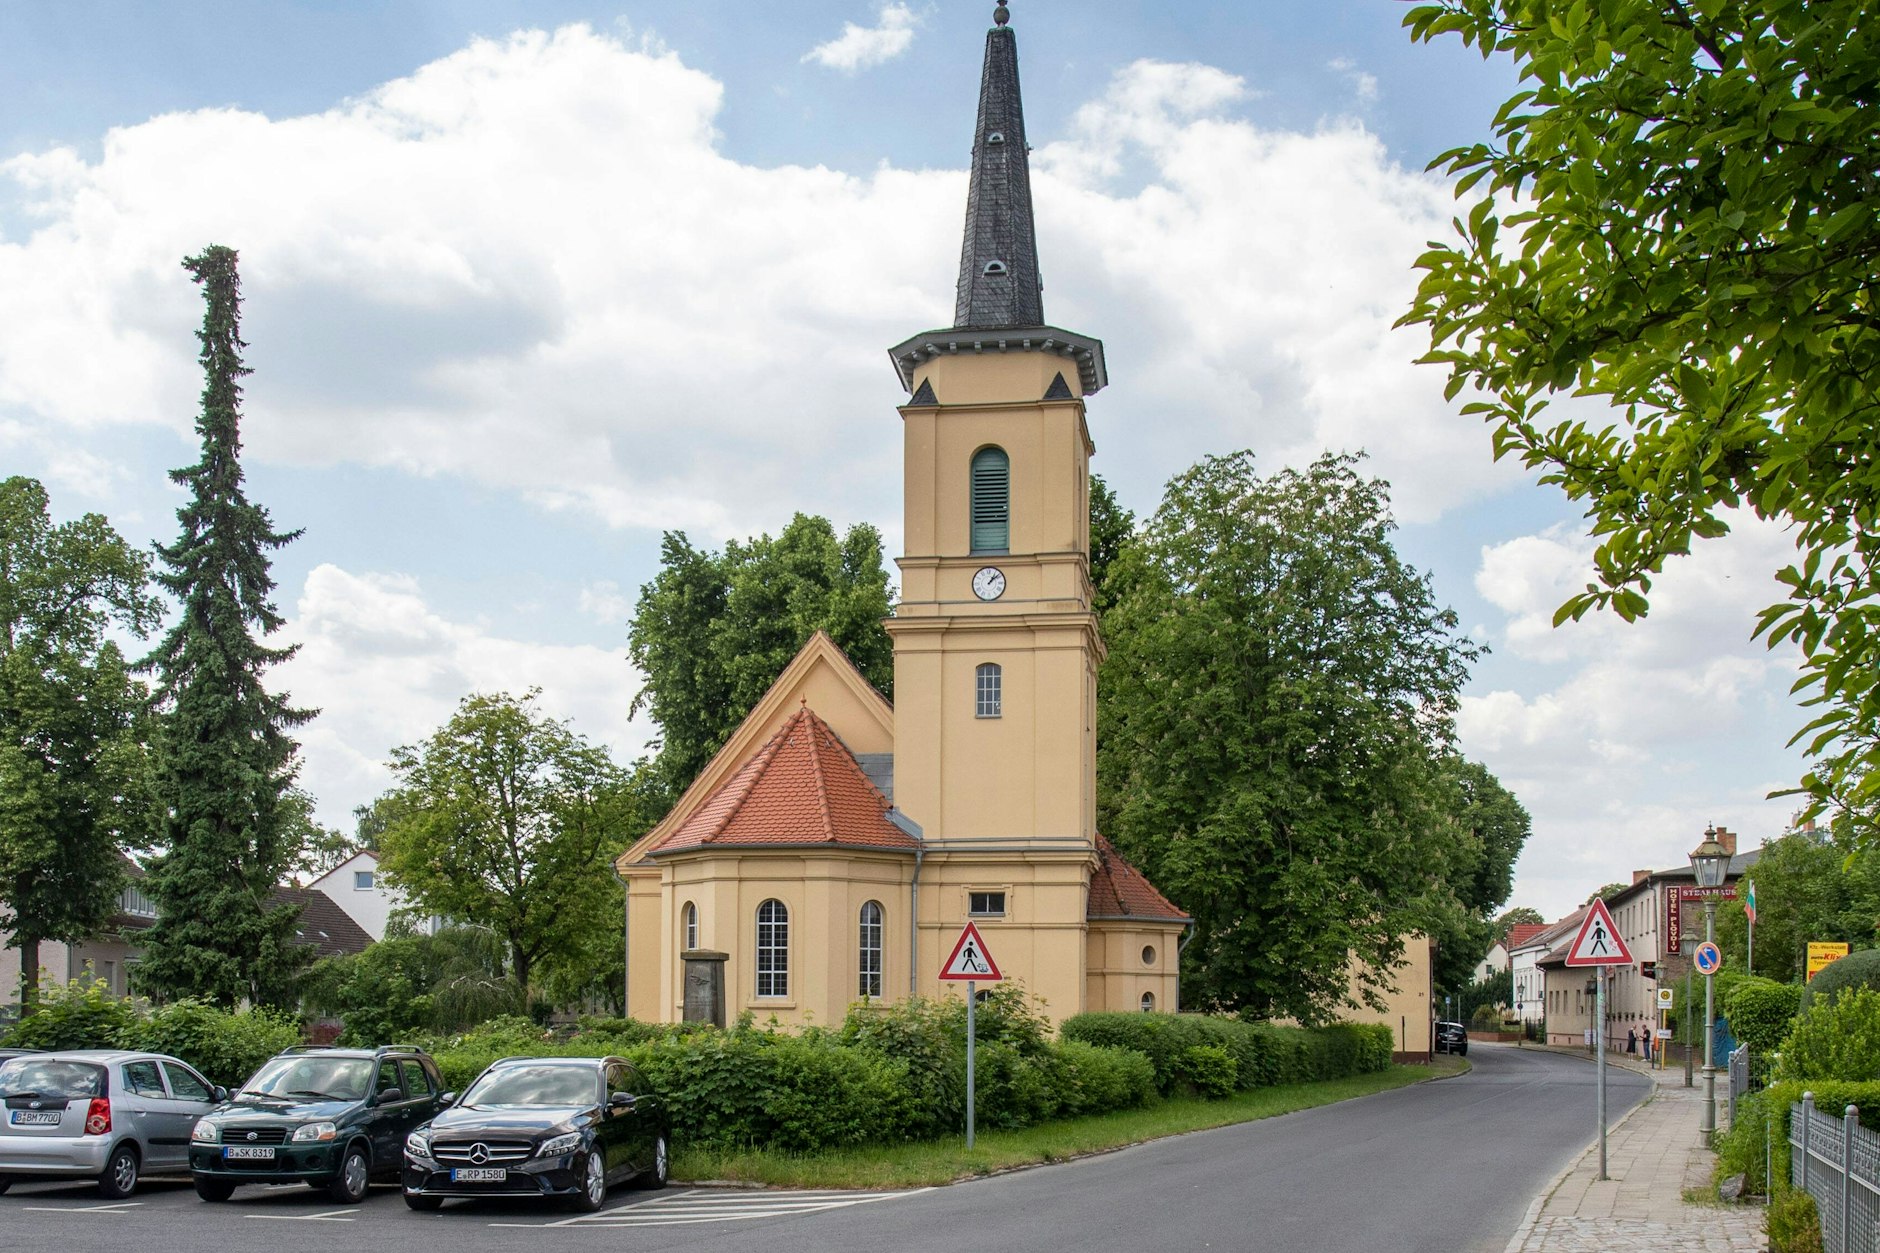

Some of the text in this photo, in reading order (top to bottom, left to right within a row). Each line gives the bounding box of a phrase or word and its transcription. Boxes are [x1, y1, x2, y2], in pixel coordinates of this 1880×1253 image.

[1669, 889, 1678, 951] HOTEL PLOVDIV
[39, 1113, 59, 1122] 7700
[229, 1148, 274, 1157] B SK 8319
[456, 1170, 505, 1179] E RP 1580
